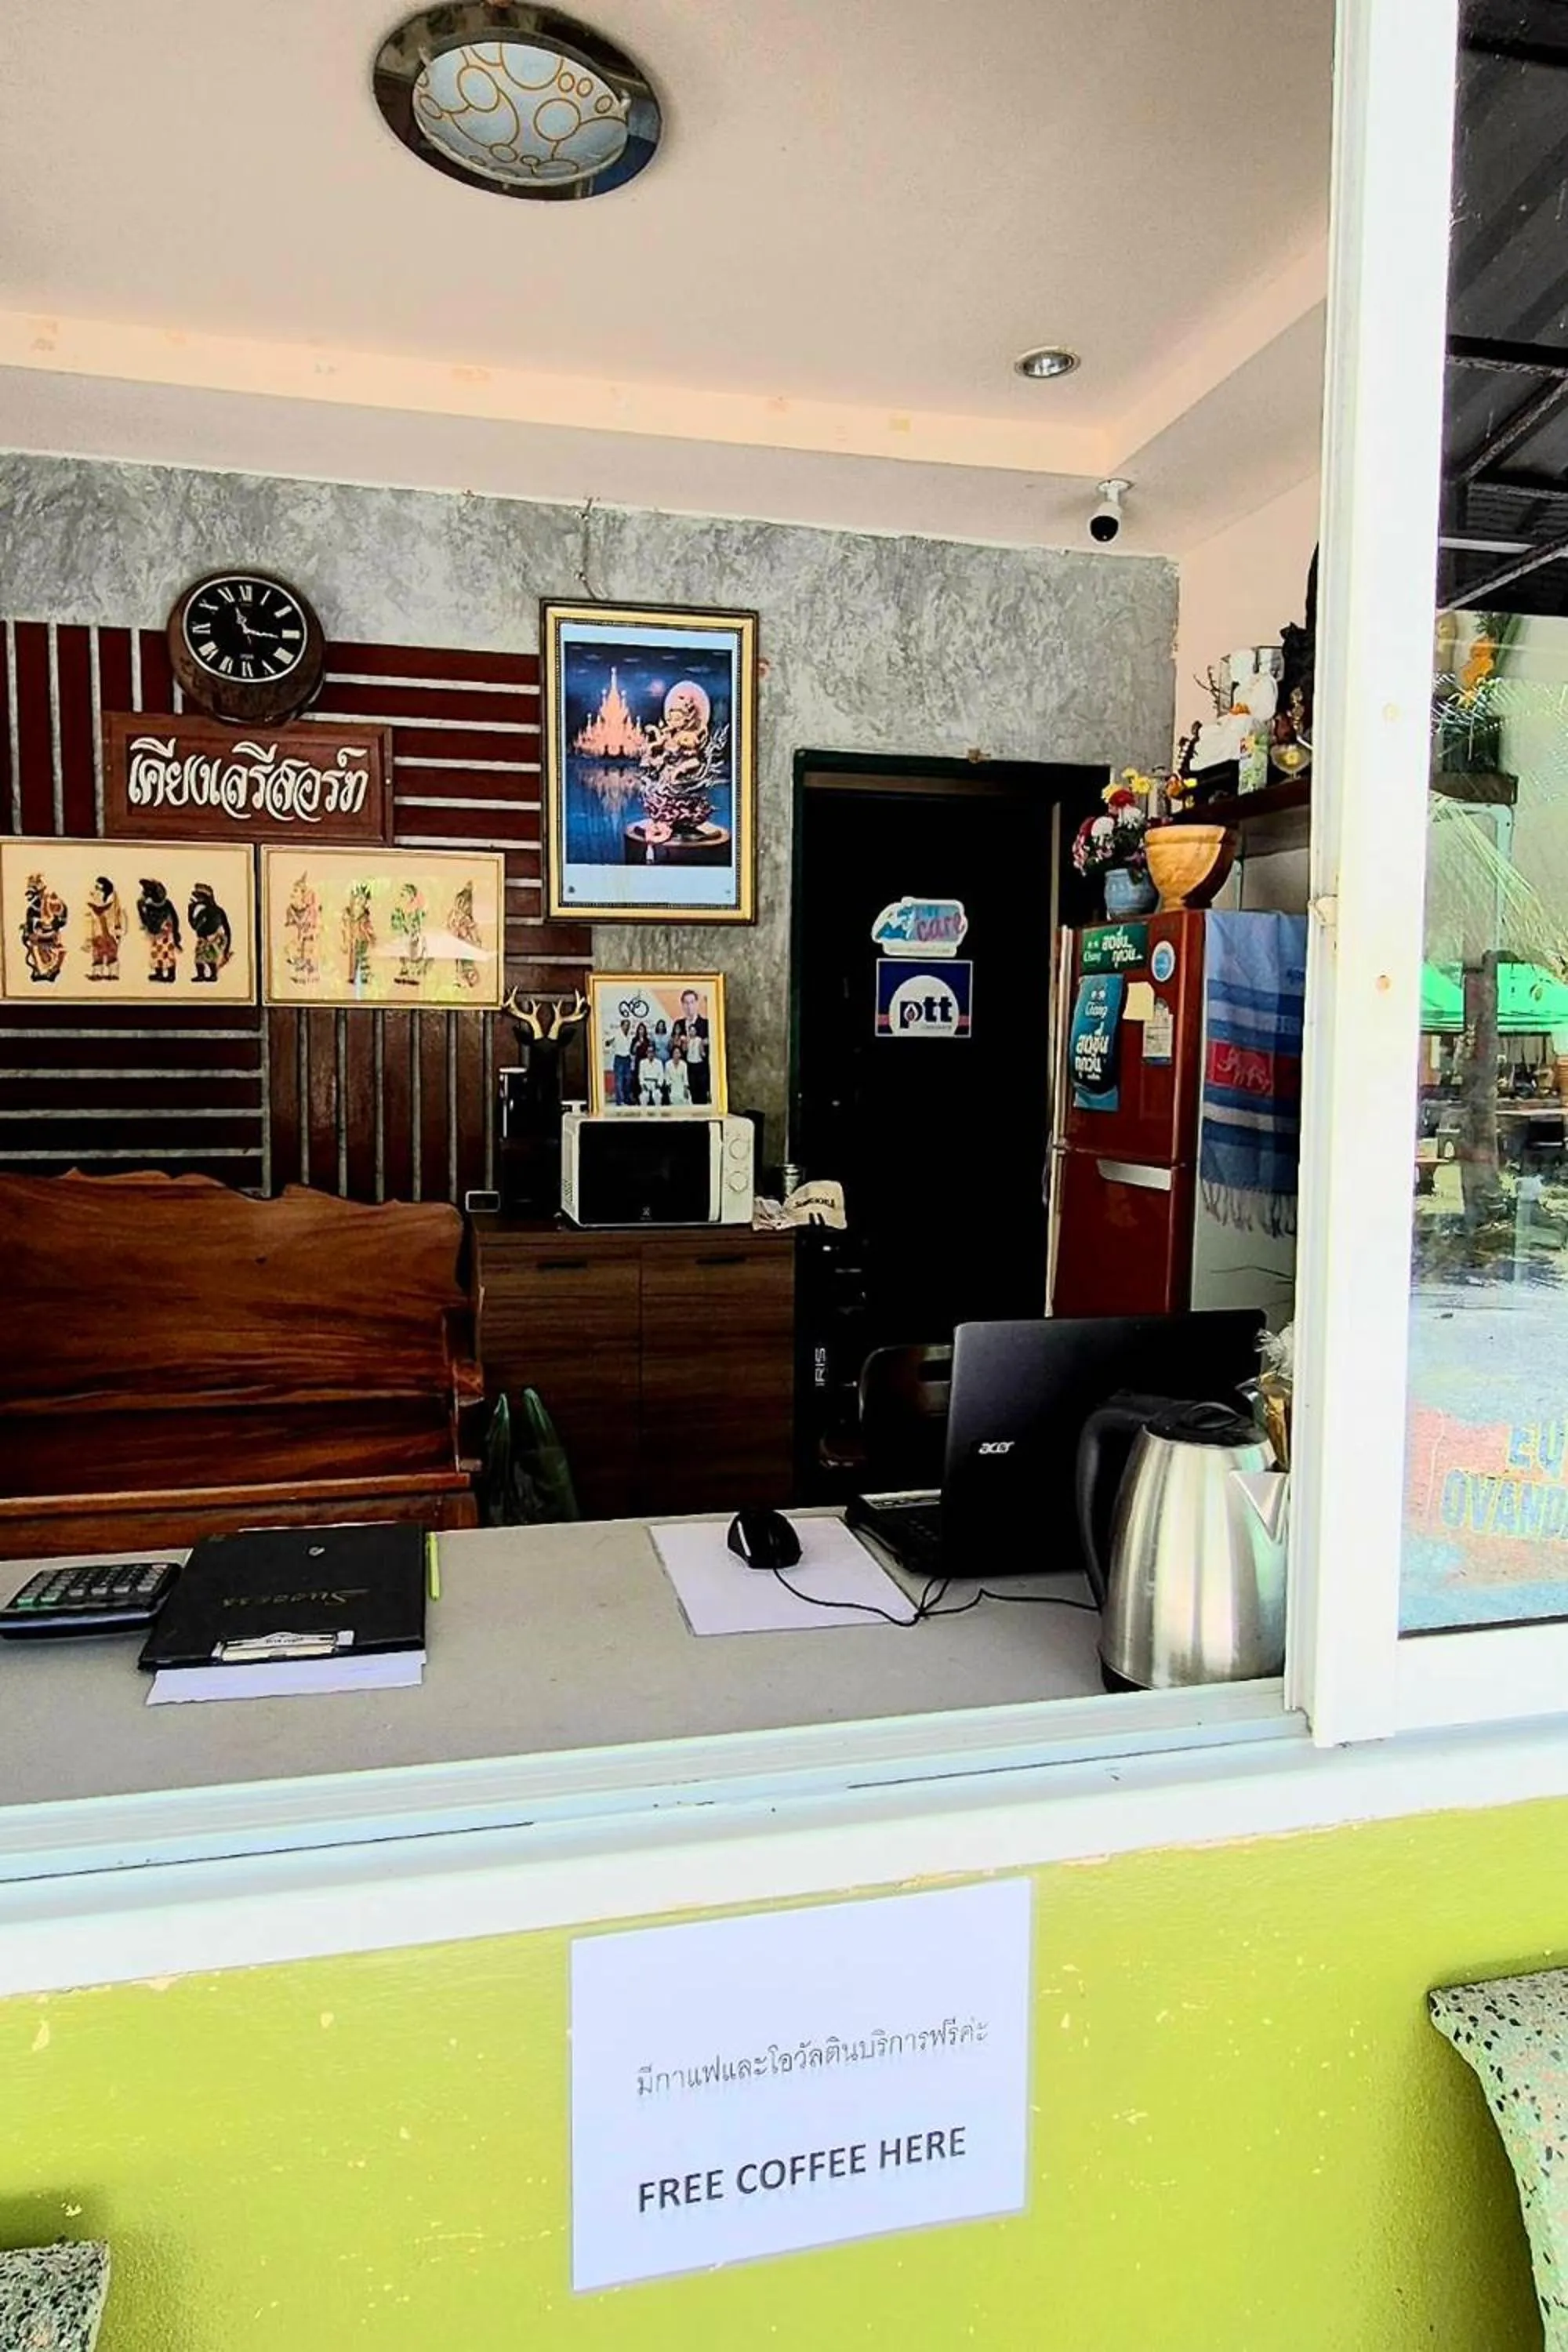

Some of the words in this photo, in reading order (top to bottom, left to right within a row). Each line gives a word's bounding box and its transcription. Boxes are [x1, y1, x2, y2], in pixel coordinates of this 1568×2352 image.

[900, 996, 953, 1029] ptt
[815, 1348, 826, 1387] IRIS
[978, 1441, 1014, 1454] acer
[638, 2169, 724, 2212] FREE
[736, 2143, 866, 2195] COFFEE
[879, 2126, 967, 2169] HERE
